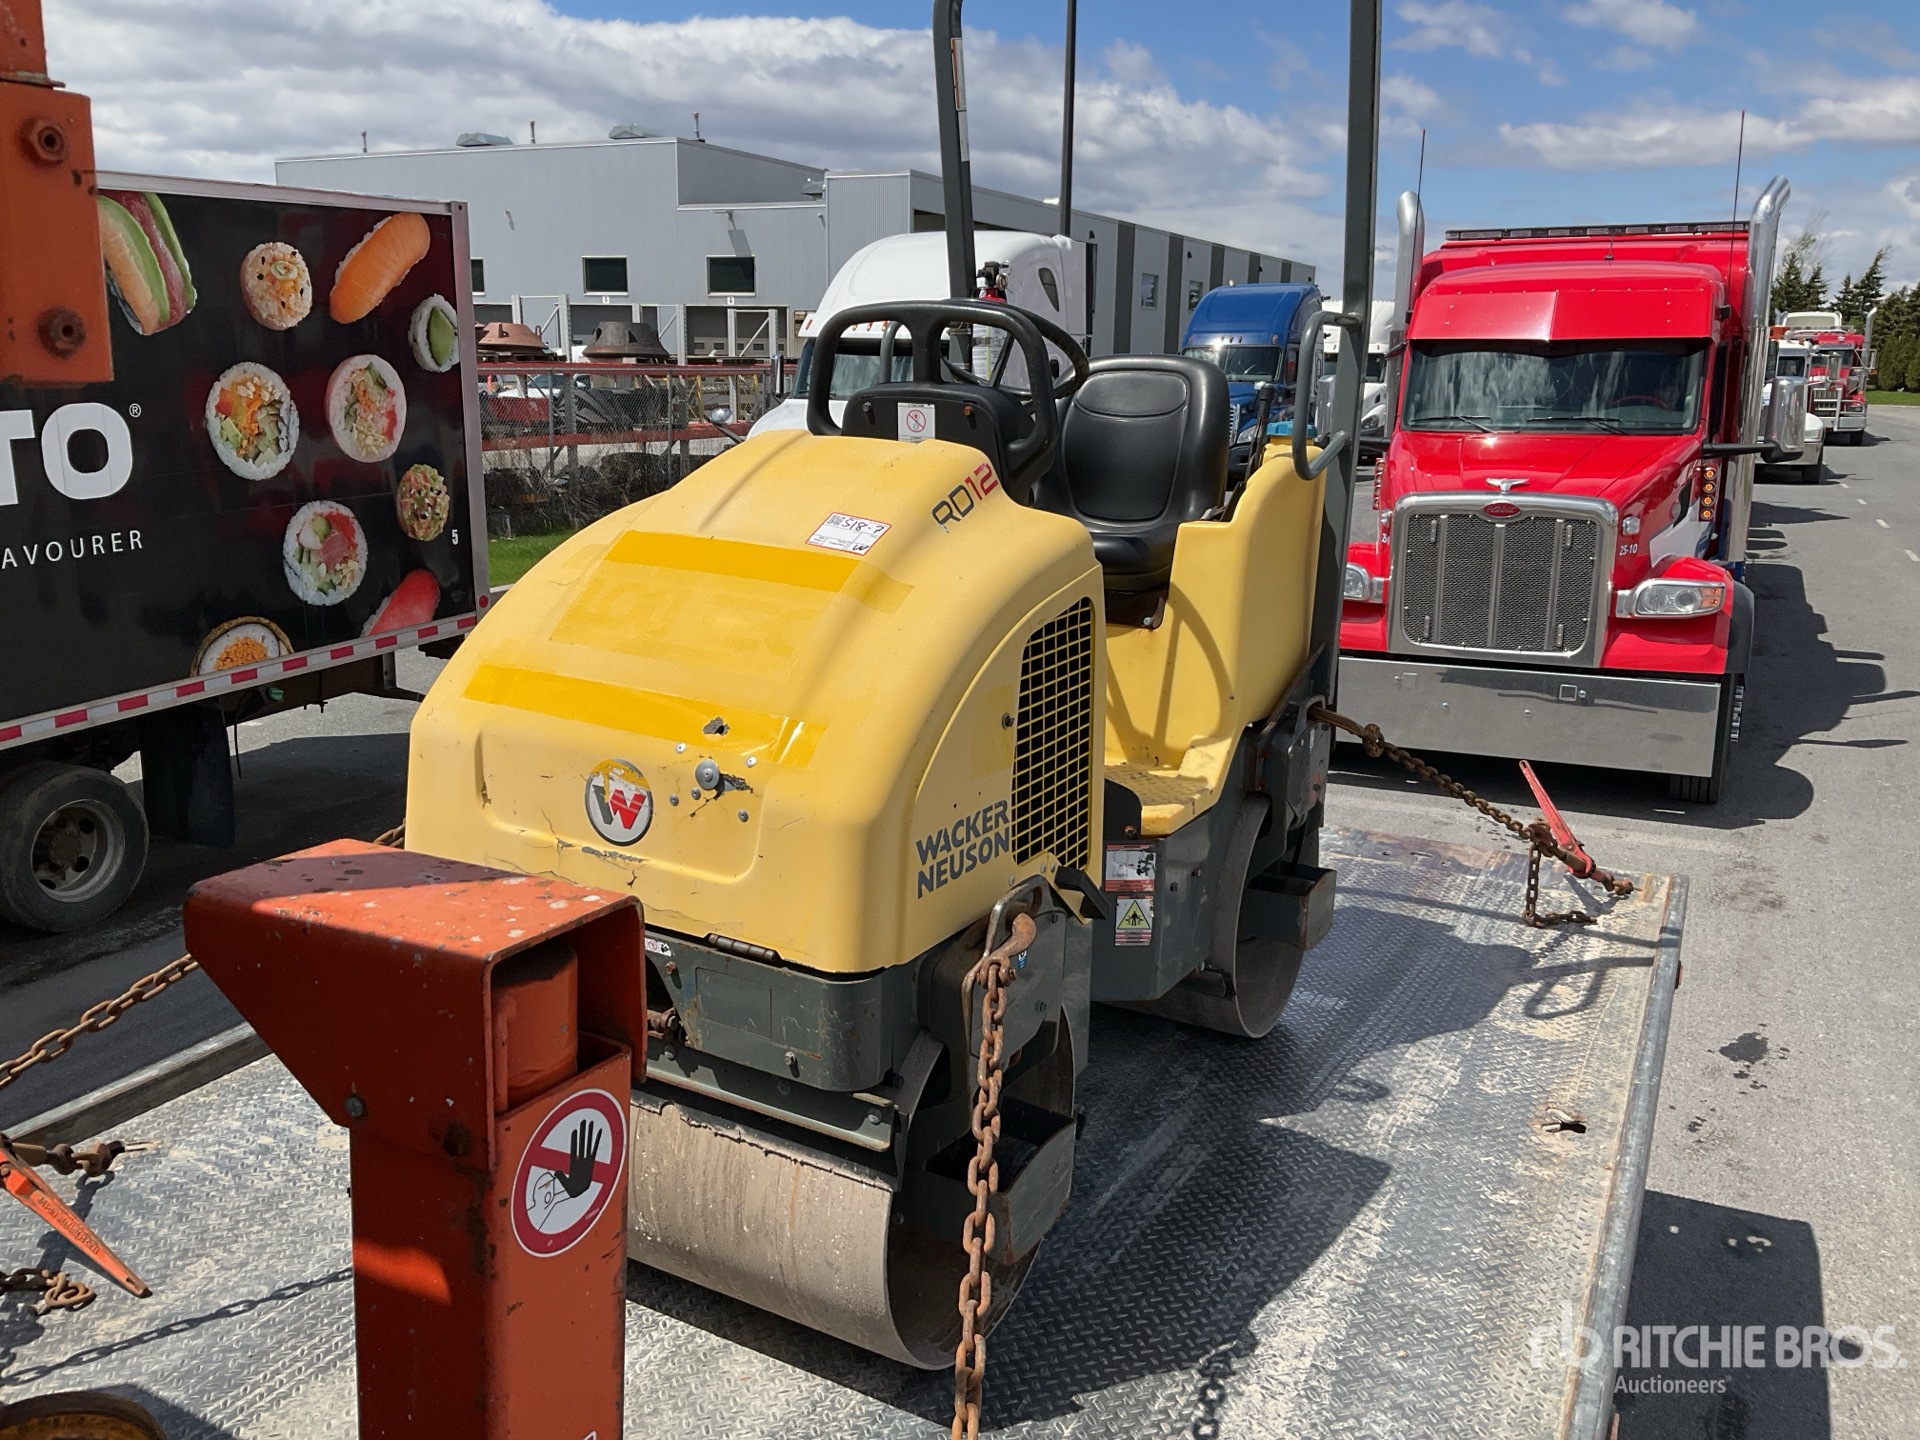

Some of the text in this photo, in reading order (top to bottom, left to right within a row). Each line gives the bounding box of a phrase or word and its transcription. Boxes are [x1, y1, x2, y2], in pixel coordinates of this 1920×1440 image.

[452, 529, 459, 545] 5
[1619, 544, 1638, 556] 25-10
[916, 799, 1010, 866] WACKER
[917, 826, 1010, 899] NEUSON
